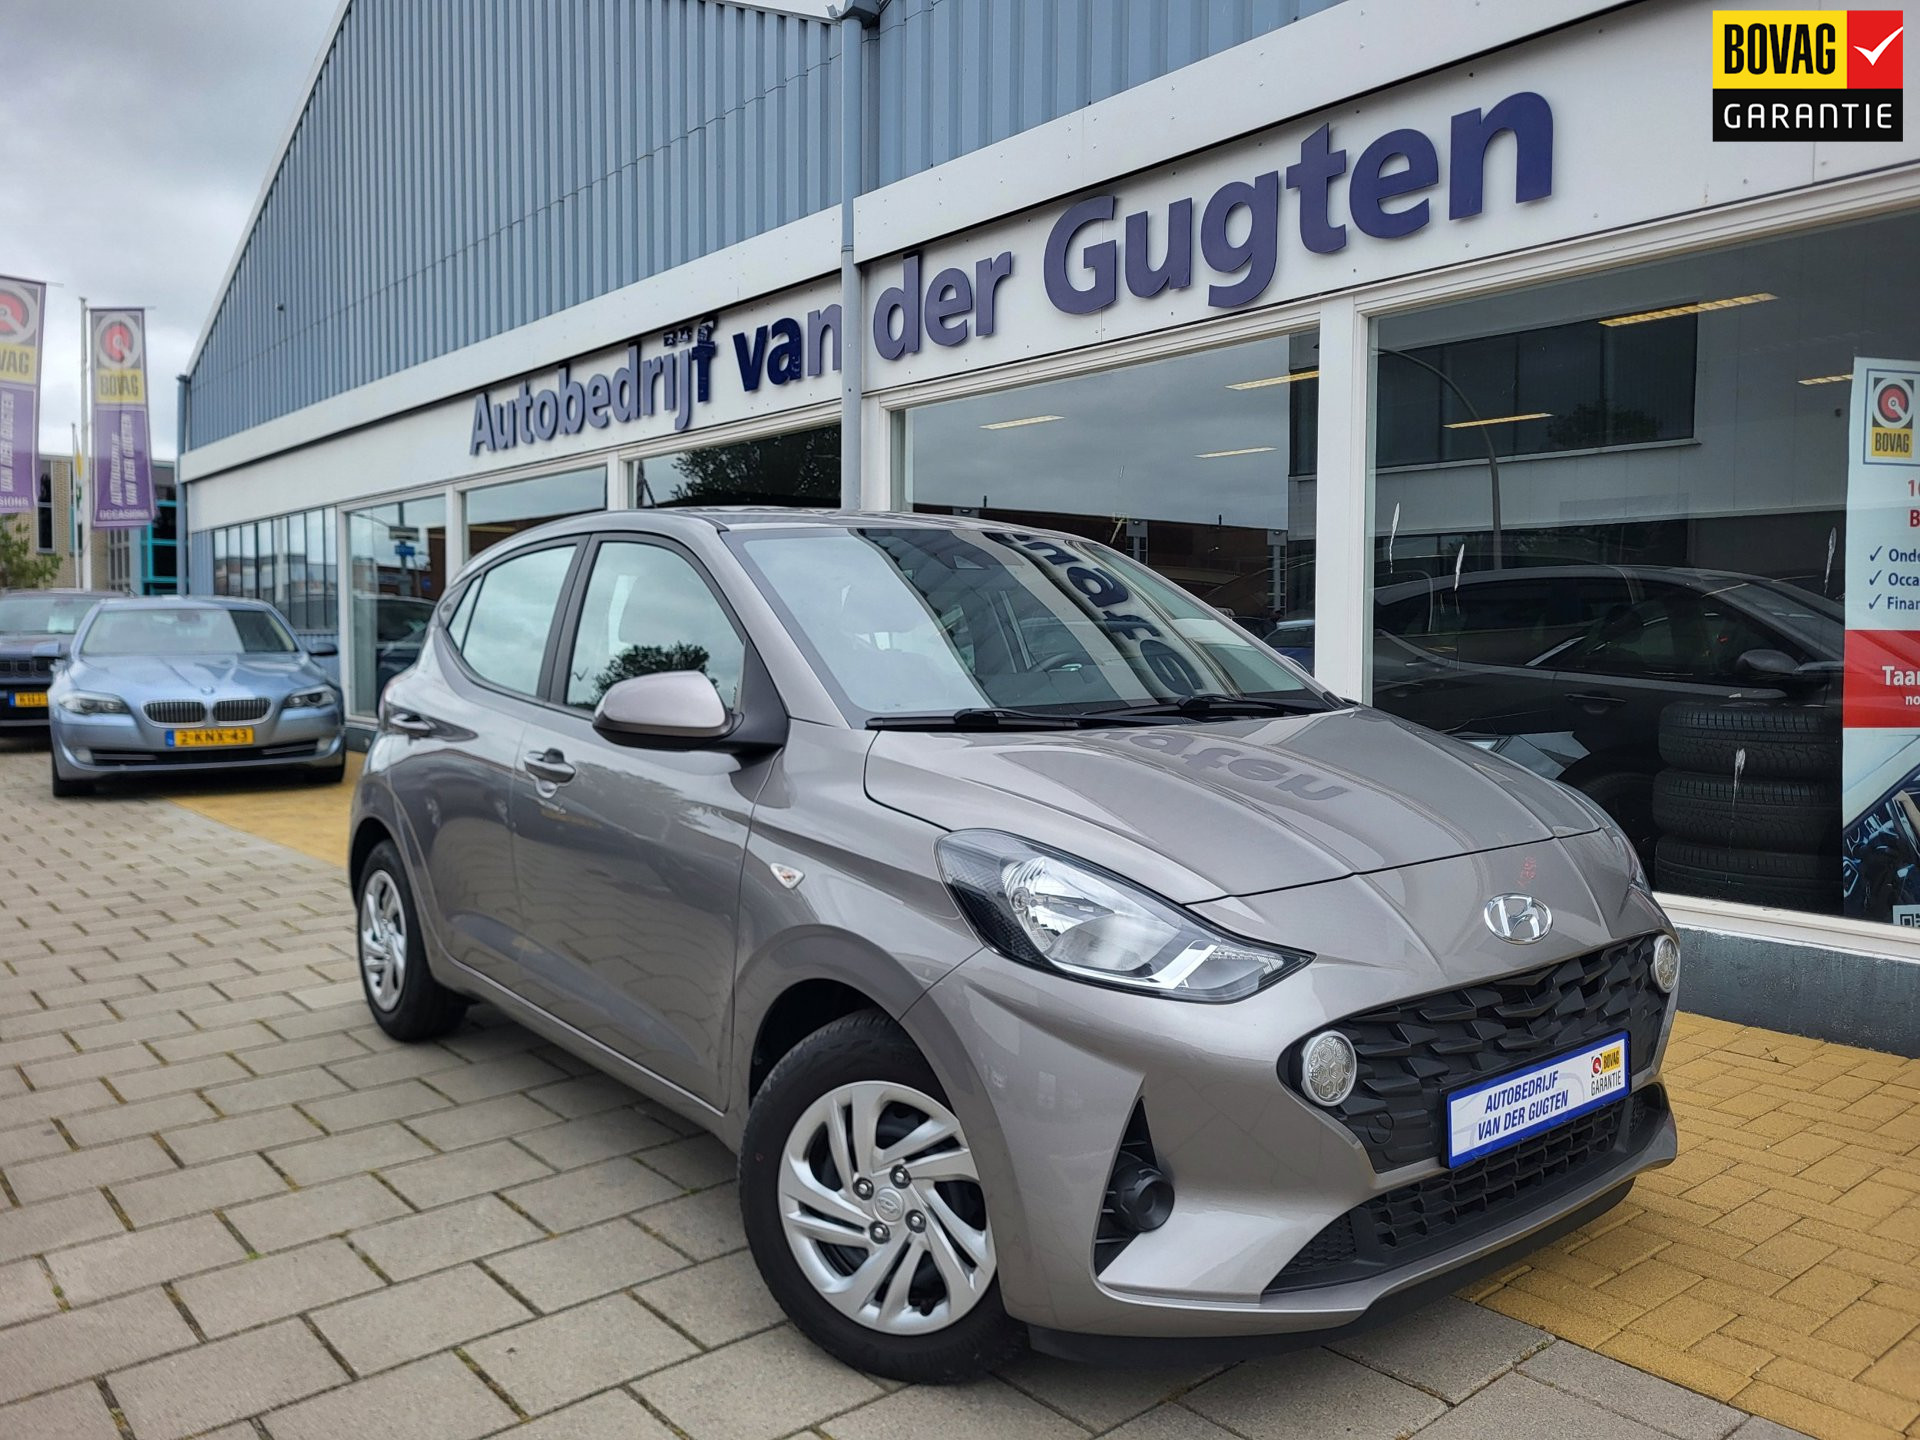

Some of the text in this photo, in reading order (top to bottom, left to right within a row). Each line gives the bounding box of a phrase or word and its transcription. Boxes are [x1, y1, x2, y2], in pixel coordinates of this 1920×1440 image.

[469, 91, 1554, 456] Autobedrijf van der Gugten
[100, 374, 139, 396] BOVAG
[1875, 432, 1910, 453] BOVAG
[1603, 1050, 1620, 1070] BOVAG
[1485, 1070, 1559, 1114] AUTOBEDRIJF
[1591, 1071, 1621, 1096] GARANTIE
[1478, 1090, 1569, 1141] VAN DER GUGTEN
